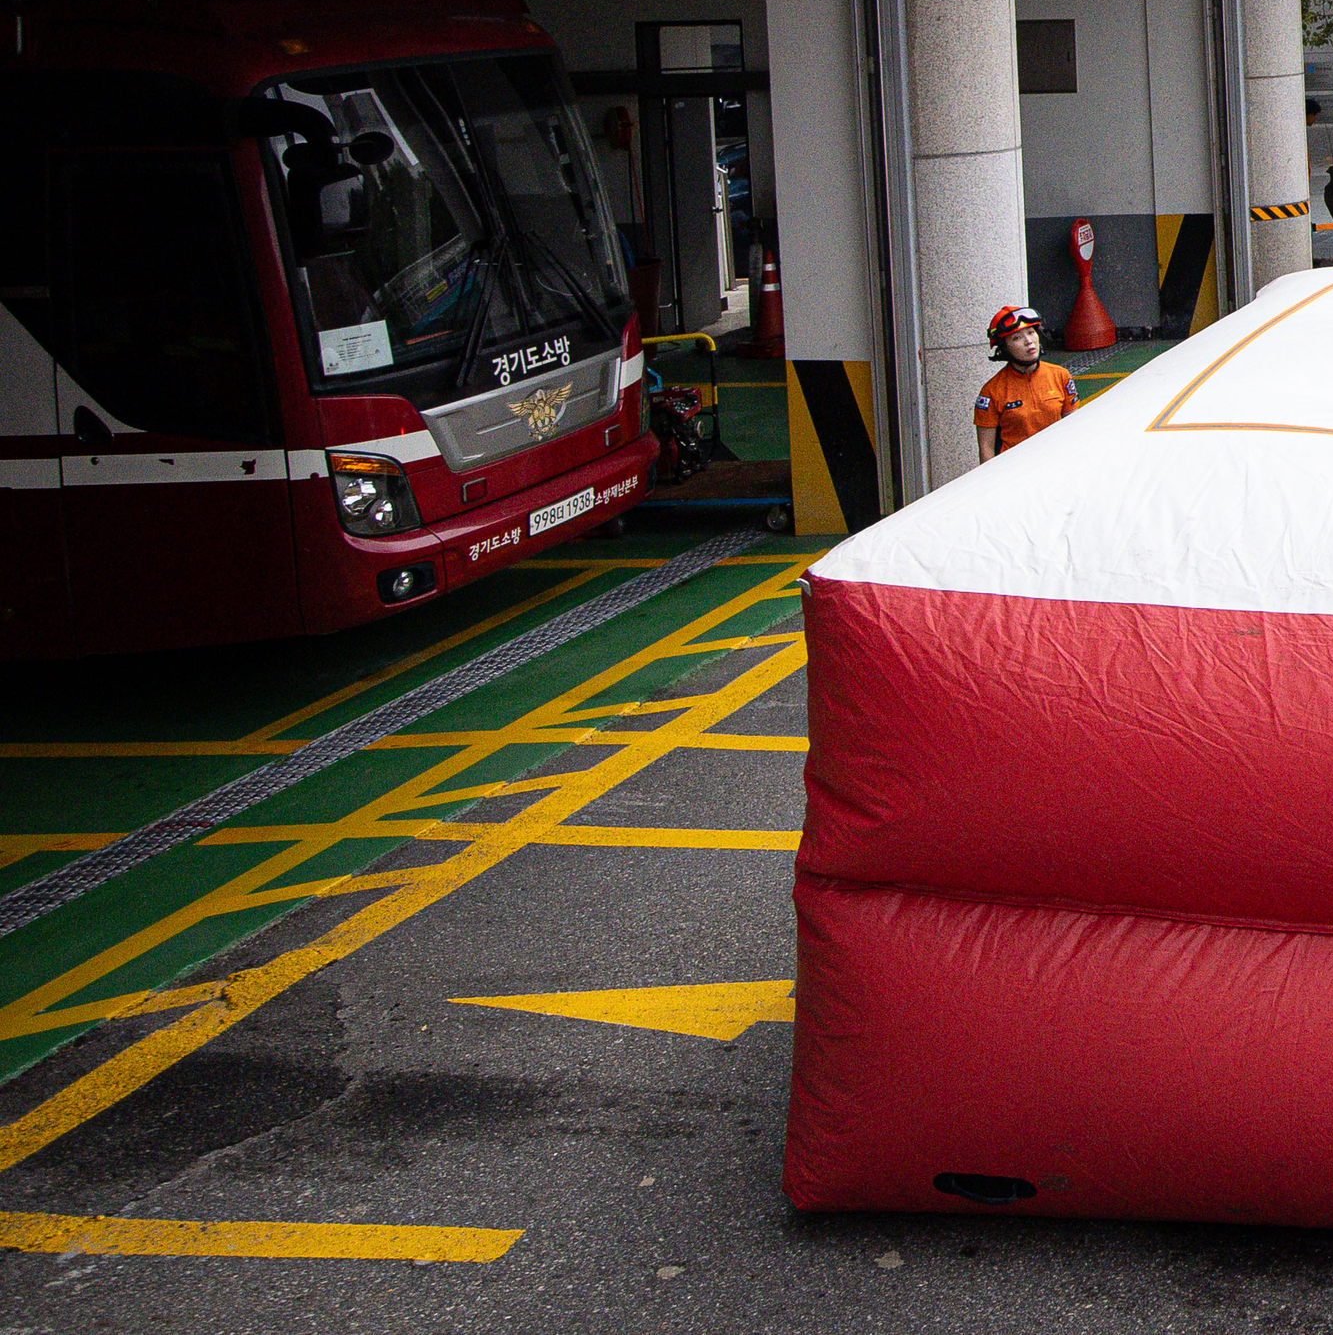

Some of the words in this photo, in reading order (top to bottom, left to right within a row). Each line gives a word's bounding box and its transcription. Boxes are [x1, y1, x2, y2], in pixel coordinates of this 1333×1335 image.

[492, 335, 571, 386] 경기도소방
[594, 474, 639, 505] 소방재난본부
[469, 526, 522, 561] 경기도소방
